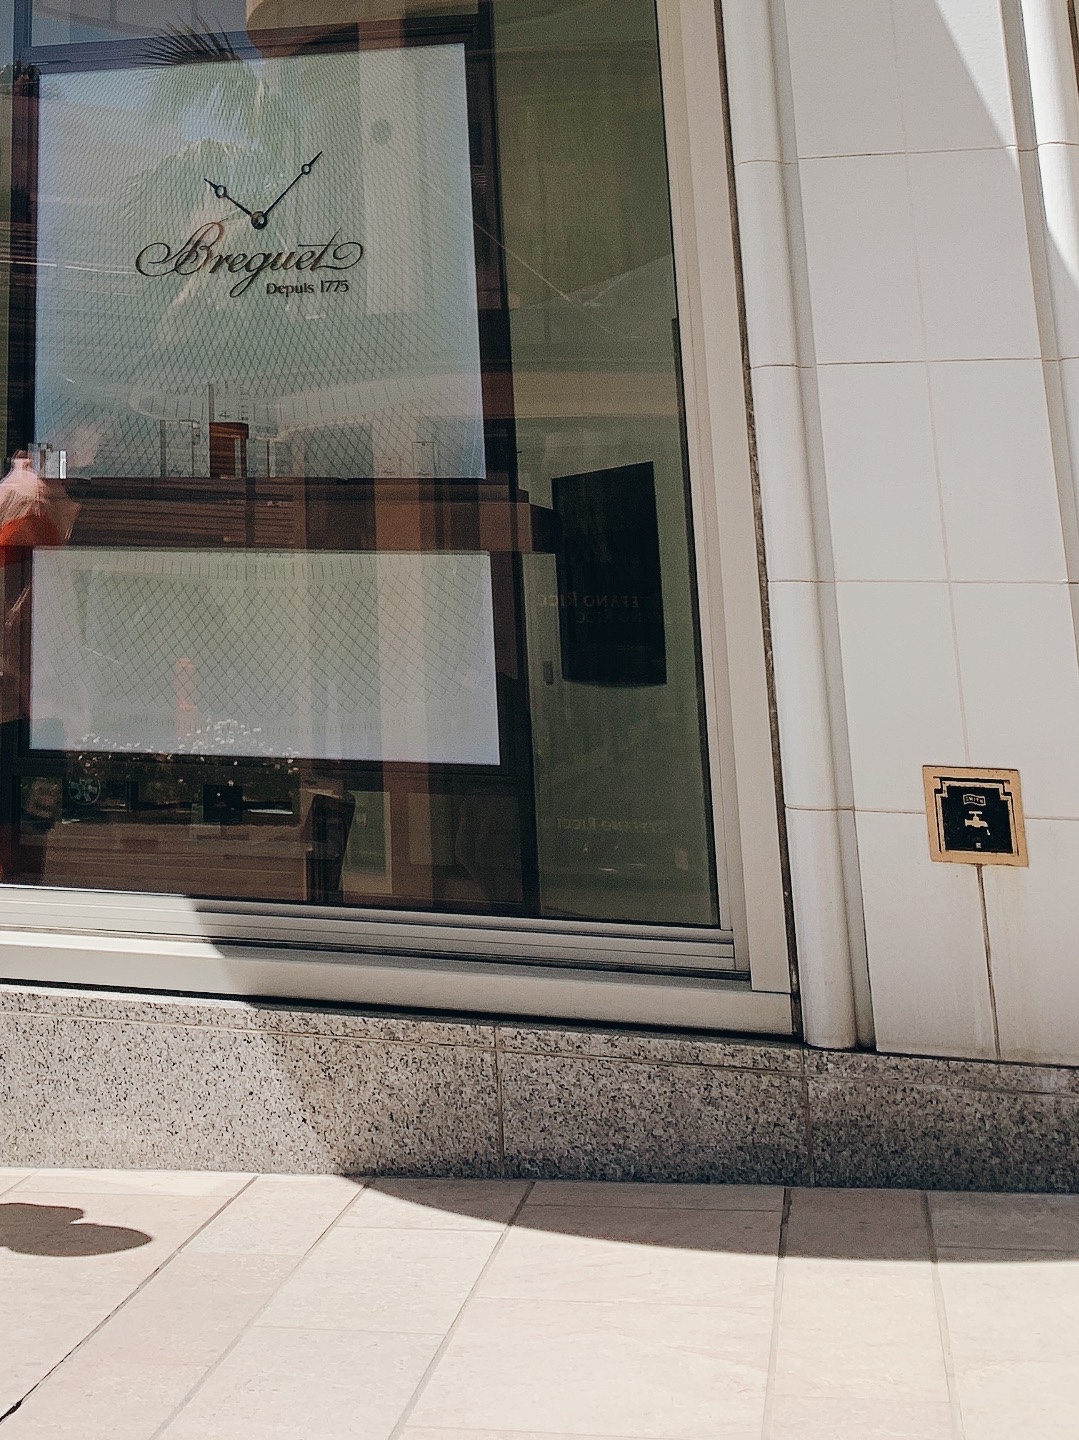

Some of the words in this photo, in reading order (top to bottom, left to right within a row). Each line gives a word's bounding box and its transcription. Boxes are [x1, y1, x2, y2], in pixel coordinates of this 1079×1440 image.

[135, 219, 364, 298] Breguet
[266, 282, 315, 298] Depuis
[320, 279, 350, 293] 1775
